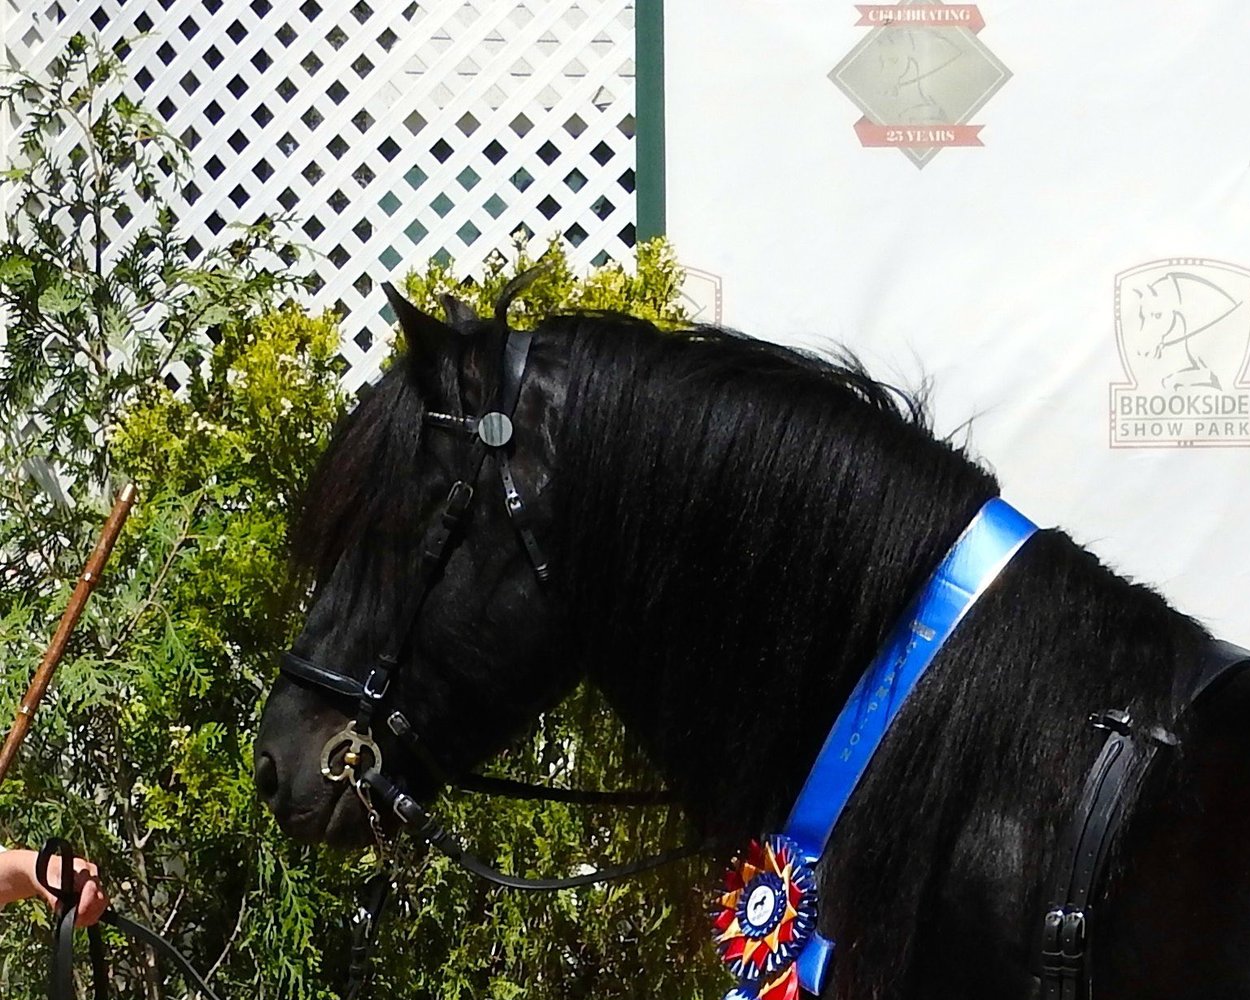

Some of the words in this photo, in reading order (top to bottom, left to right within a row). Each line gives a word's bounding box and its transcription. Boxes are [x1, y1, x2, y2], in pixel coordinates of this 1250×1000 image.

[868, 9, 971, 21] CELEBRATING
[886, 130, 904, 142] 25
[907, 130, 955, 142] YEARS
[1120, 394, 1250, 416] BROOKSIDE
[1120, 422, 1183, 437] SHOW
[1195, 422, 1250, 436] PARK
